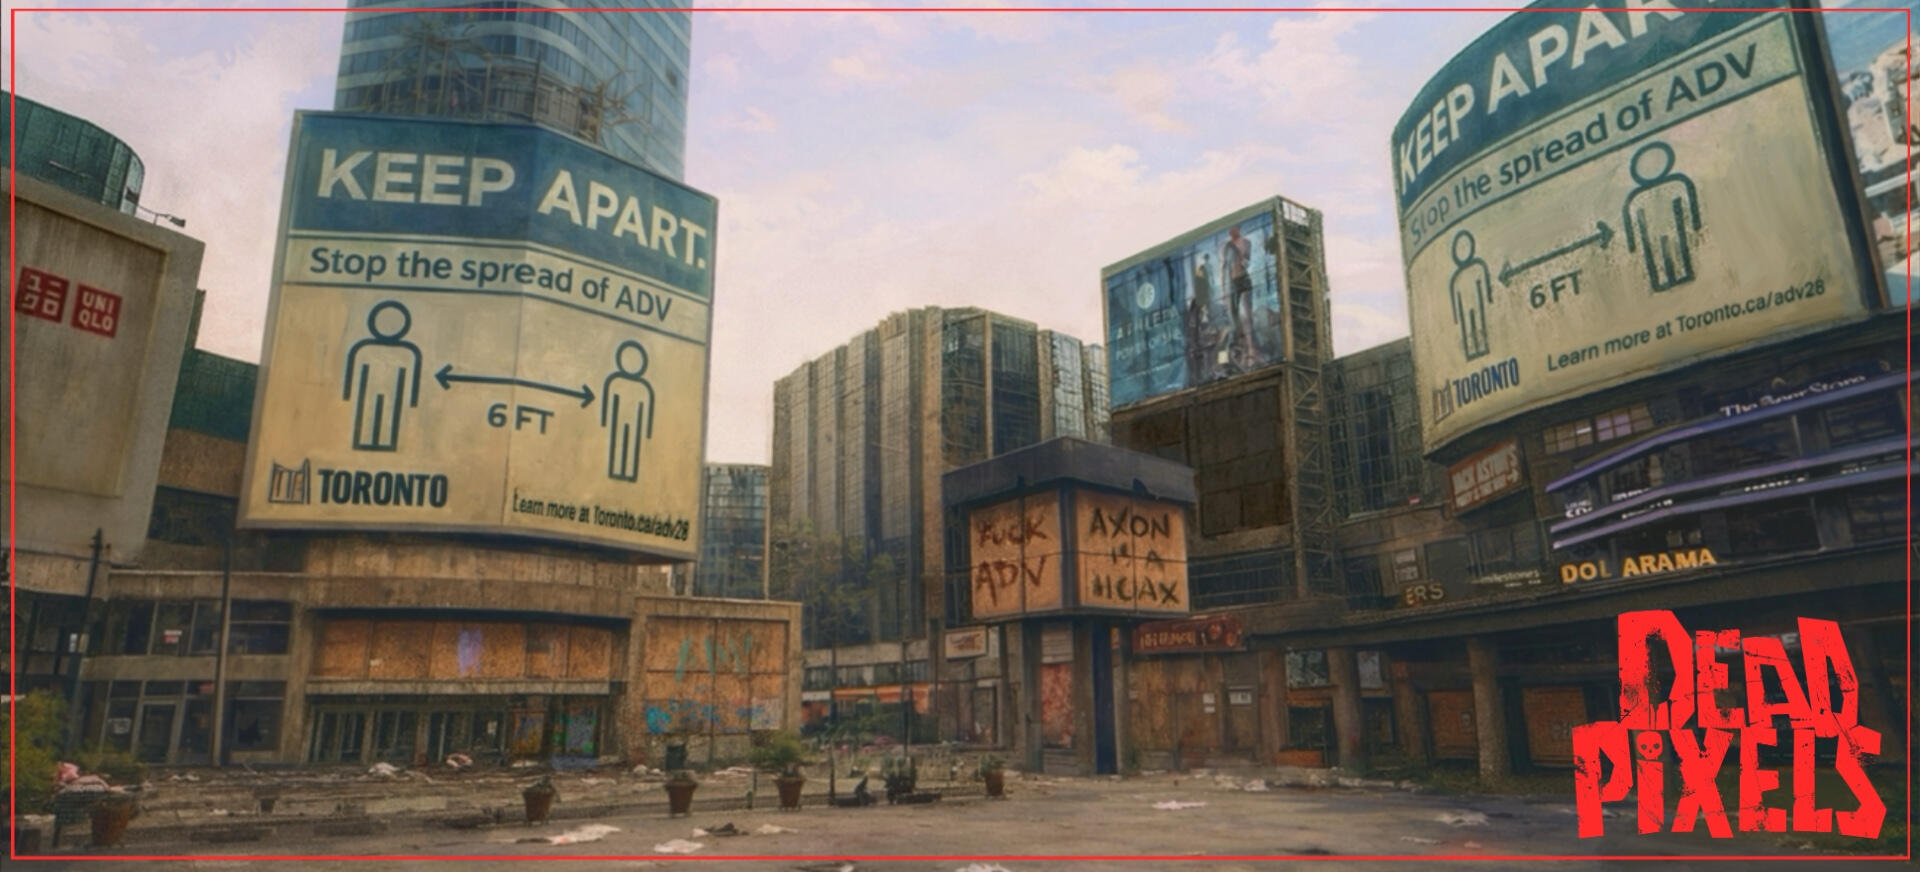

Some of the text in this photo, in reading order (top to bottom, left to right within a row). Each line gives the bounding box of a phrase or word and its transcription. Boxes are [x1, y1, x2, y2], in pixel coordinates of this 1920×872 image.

[1399, 0, 1716, 196] KEEP APAR
[1454, 172, 1492, 209] the
[1499, 112, 1609, 185] spread
[1616, 89, 1654, 131] of
[1665, 43, 1759, 112] ADV
[317, 147, 708, 270] KEEP APART.
[310, 246, 672, 322] Stop the spread of ADV
[1529, 270, 1584, 309] 6 FT
[1547, 278, 1826, 372] Learn more at Toronto.ca/adv28
[1453, 357, 1520, 409] TORONTO
[487, 403, 554, 435] 6 FT
[317, 468, 449, 508] TORONTO
[512, 487, 690, 542] Learn more at Toronto.ca/adv28
[976, 510, 1048, 548] FUCK
[1089, 507, 1171, 540] AXON
[974, 555, 1048, 607] ADV
[1145, 549, 1166, 573] A
